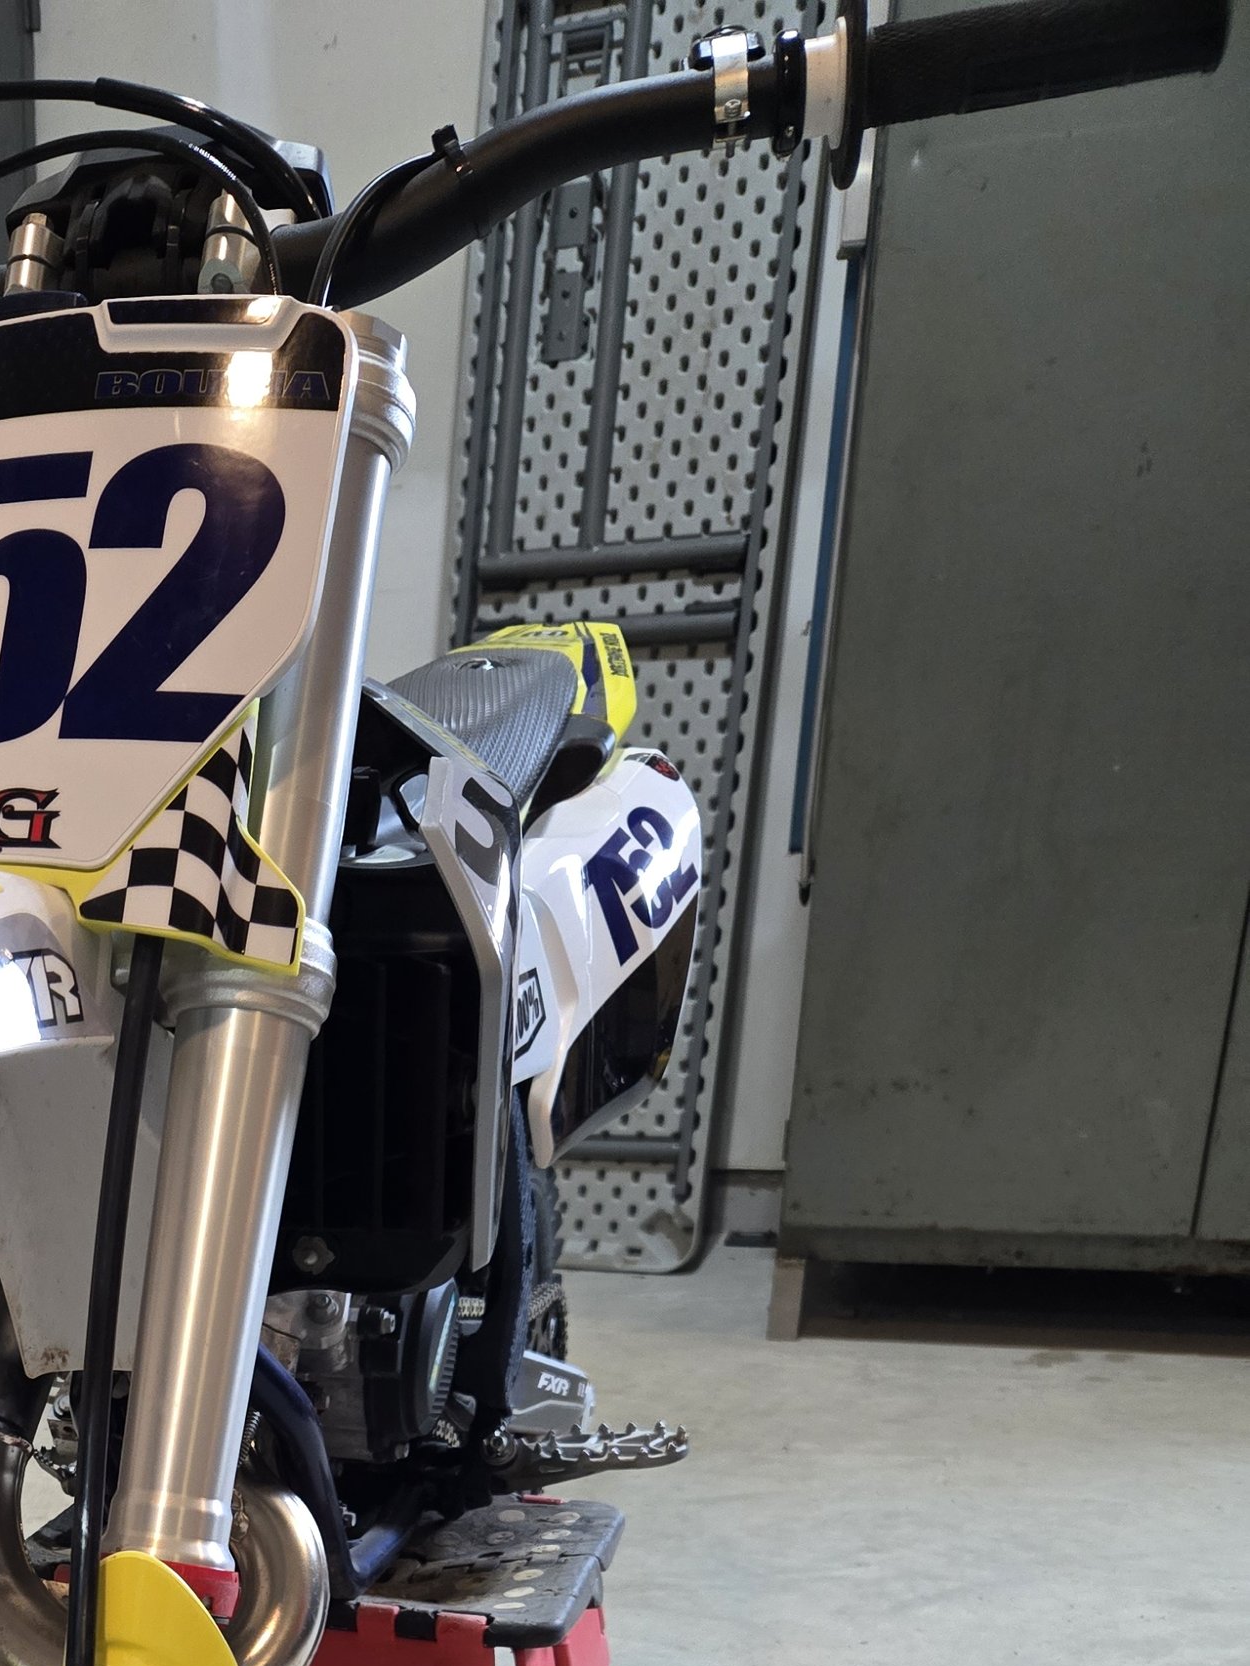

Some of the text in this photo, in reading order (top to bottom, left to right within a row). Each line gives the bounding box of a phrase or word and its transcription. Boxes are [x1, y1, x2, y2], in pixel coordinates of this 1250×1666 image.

[94, 368, 331, 400] BOUA
[515, 981, 540, 1045] 00%
[537, 1371, 570, 1397] FXR
